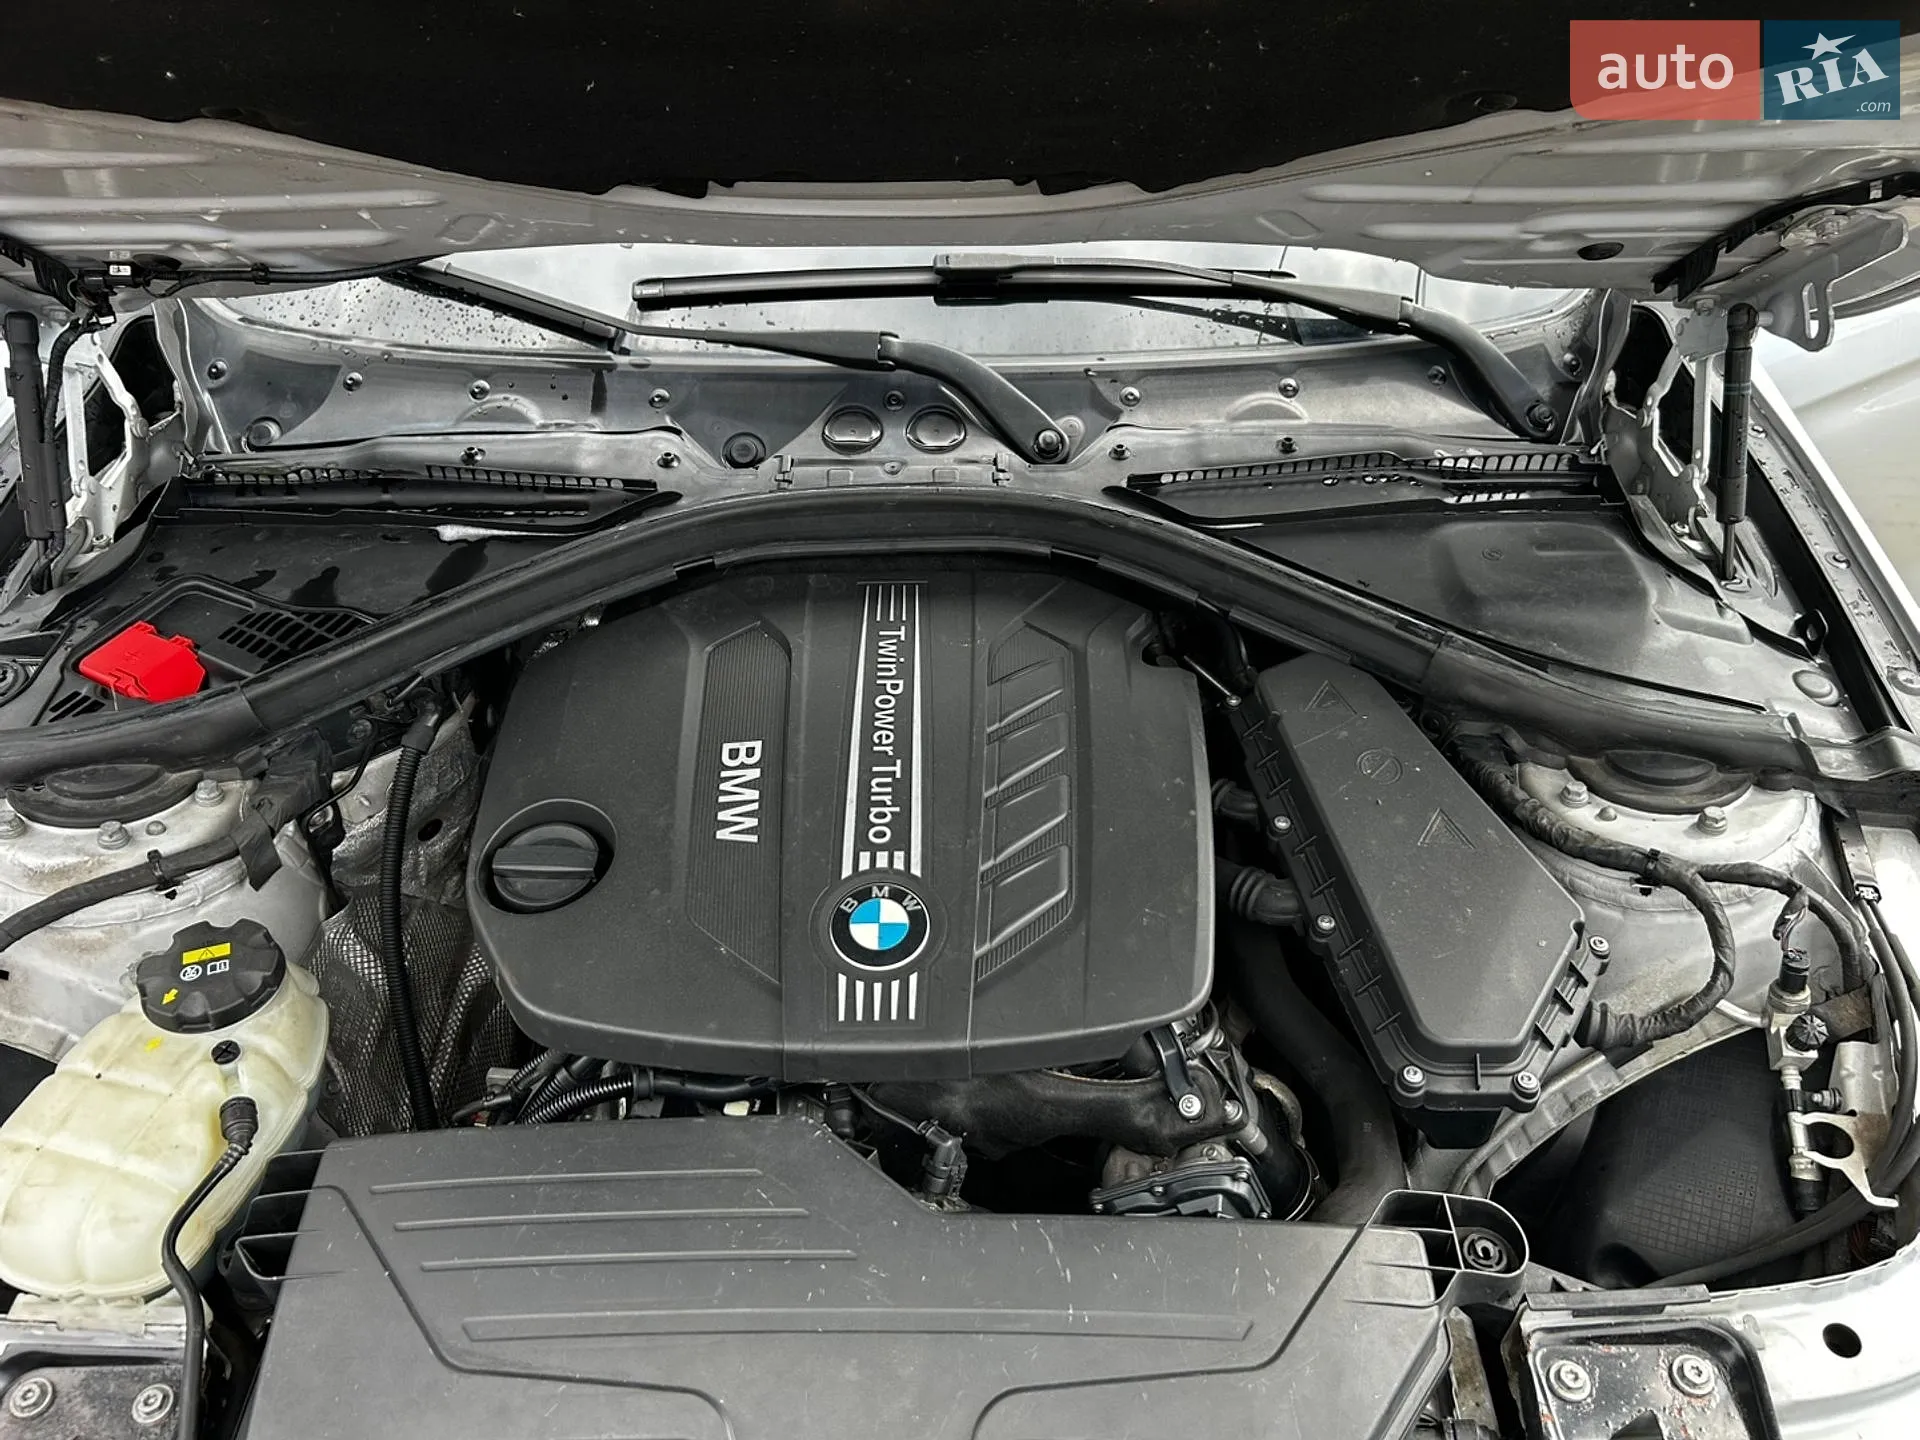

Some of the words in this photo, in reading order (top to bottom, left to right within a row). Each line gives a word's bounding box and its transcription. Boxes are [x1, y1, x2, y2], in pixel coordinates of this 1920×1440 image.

[872, 625, 906, 756] TwinPower
[715, 740, 762, 843] BMW
[868, 759, 902, 844] Turbo
[840, 886, 922, 913] BMW
